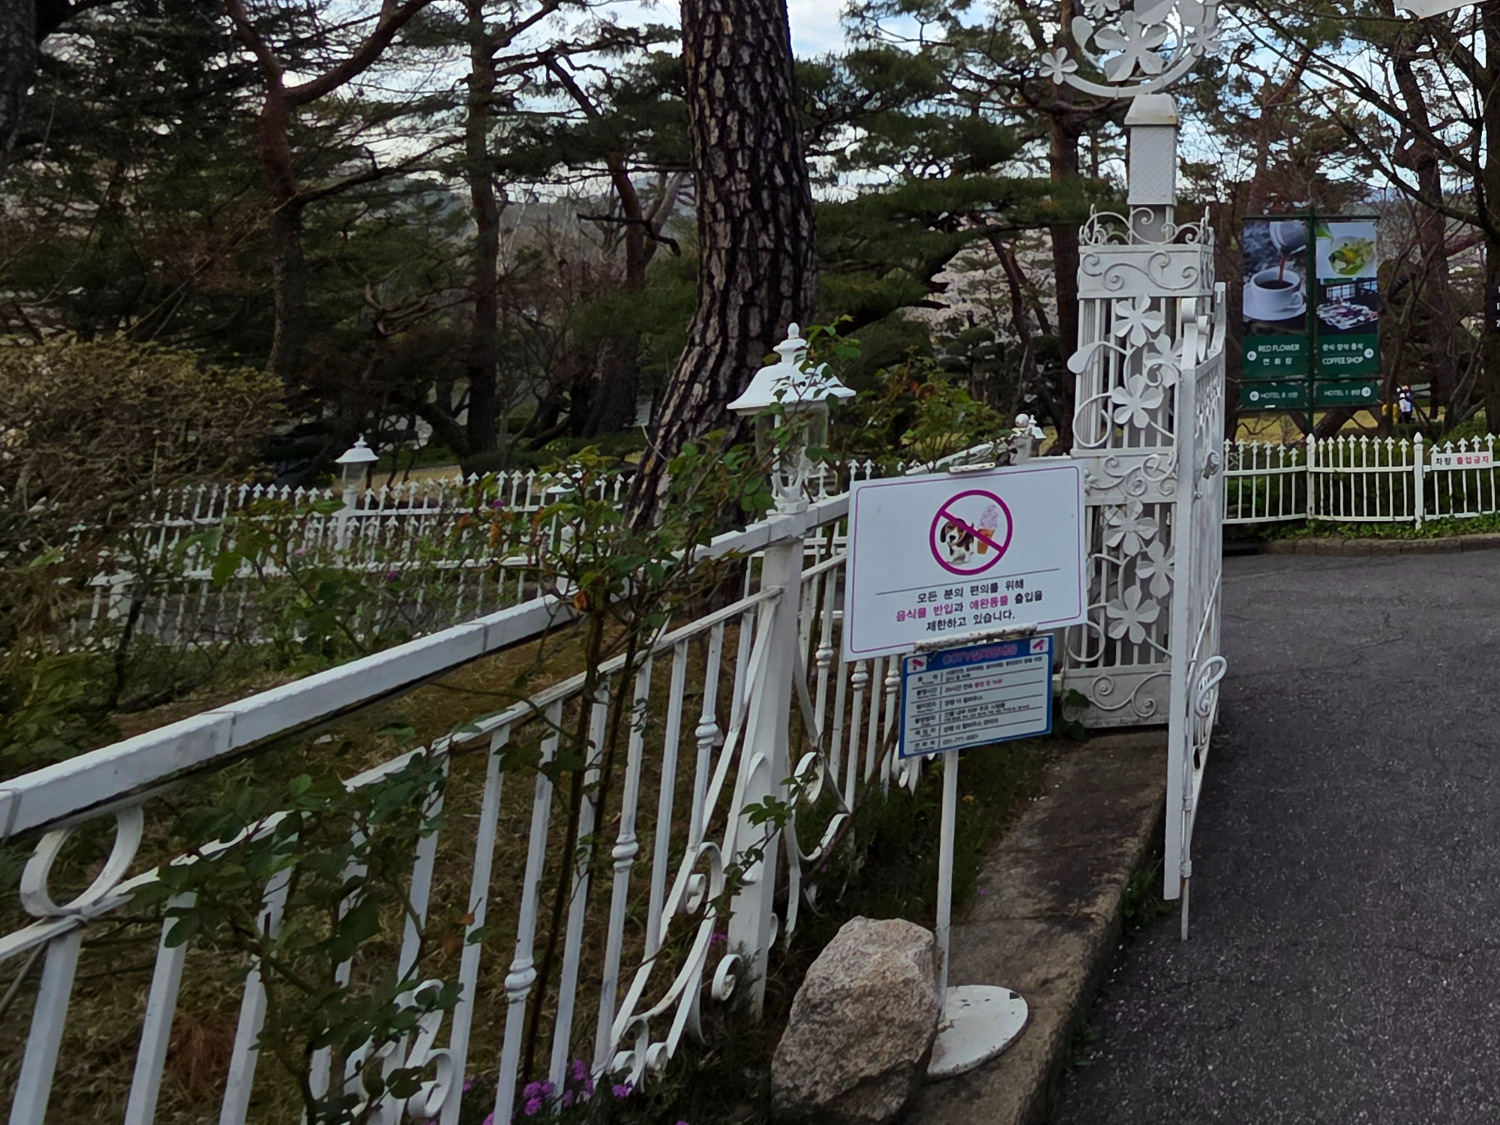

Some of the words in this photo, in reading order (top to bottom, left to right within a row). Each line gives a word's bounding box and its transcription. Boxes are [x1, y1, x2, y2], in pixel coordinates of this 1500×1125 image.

[1258, 344, 1271, 352] RED
[1272, 344, 1300, 352] FLOWER
[1322, 357, 1345, 365] COFFEE
[1346, 356, 1364, 364] SHOP
[1457, 455, 1489, 465] 출입금지
[917, 591, 937, 603] 모든
[944, 587, 964, 600] 분의
[970, 582, 999, 596] 편의를
[1005, 579, 1024, 591] 위해
[896, 607, 927, 622] 음식물
[933, 602, 964, 616] 반입과
[969, 595, 1009, 610] 애완동물
[1015, 590, 1043, 604] 출입을
[926, 616, 967, 632] 제한하고
[973, 609, 1015, 626] 있습니다.
